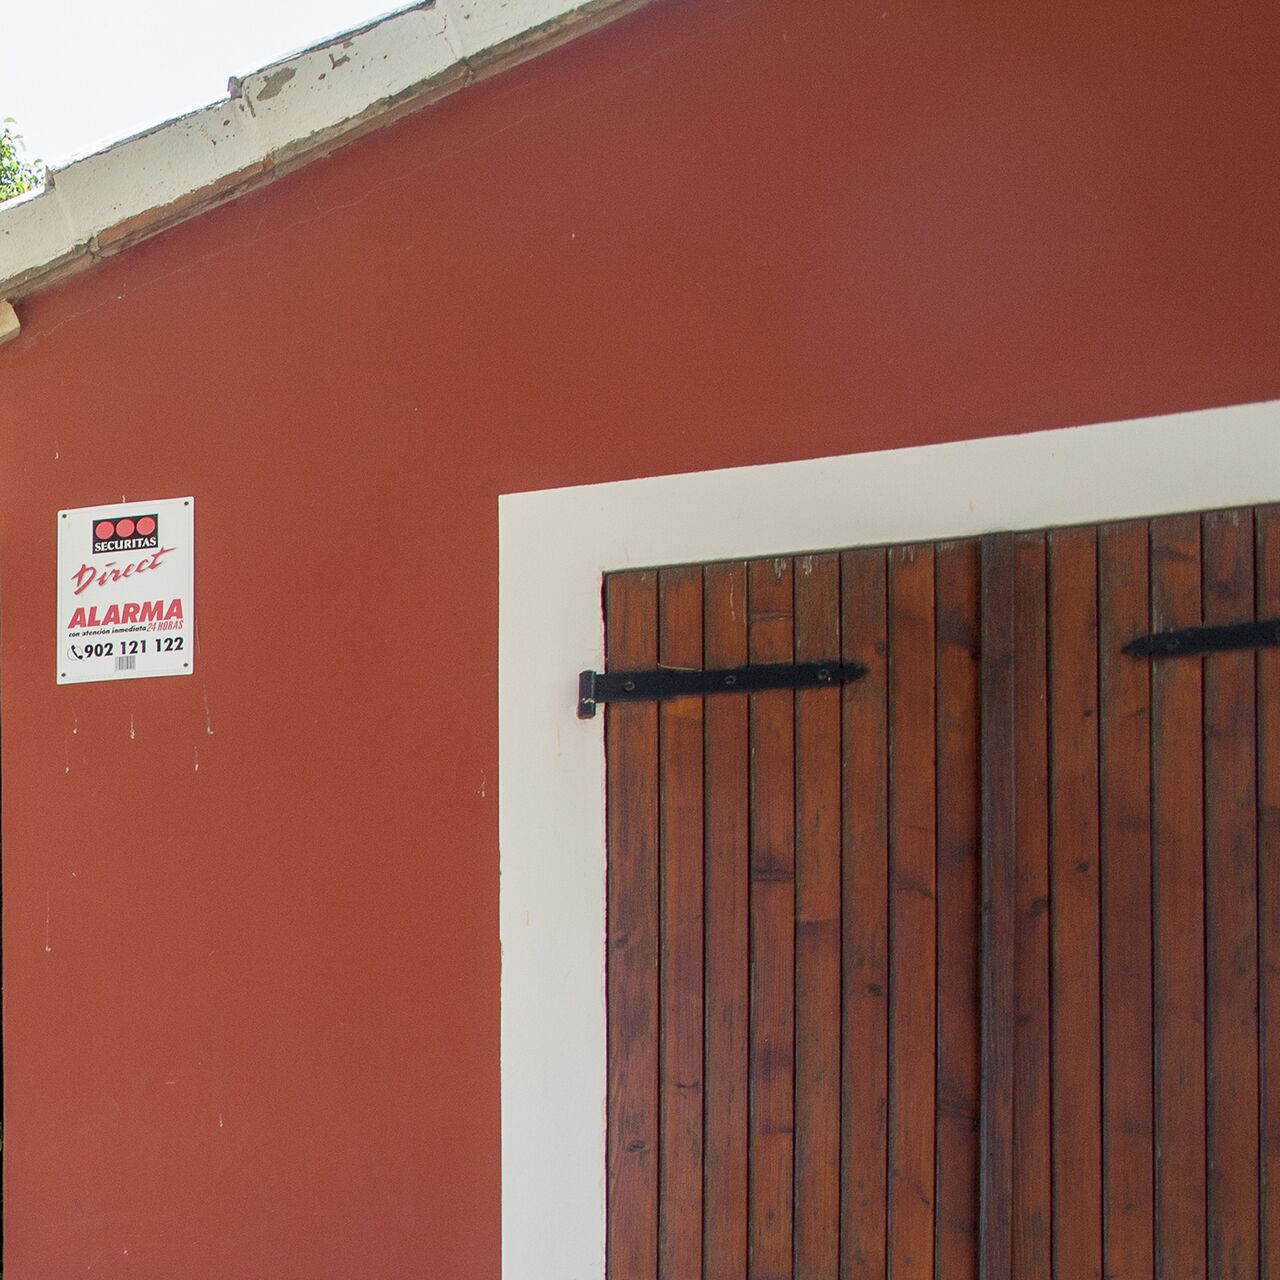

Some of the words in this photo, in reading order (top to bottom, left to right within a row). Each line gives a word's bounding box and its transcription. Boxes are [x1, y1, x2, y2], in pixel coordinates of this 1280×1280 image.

[95, 537, 157, 552] SECURITAS
[71, 546, 178, 595] Direct
[68, 598, 183, 628] ALARMA
[69, 627, 80, 637] con
[82, 628, 110, 636] atención
[112, 626, 146, 634] inmediata
[147, 622, 157, 632] 24
[157, 620, 183, 631] HORAS
[84, 643, 113, 657] 902
[120, 640, 146, 655] 121
[156, 637, 183, 651] 122
